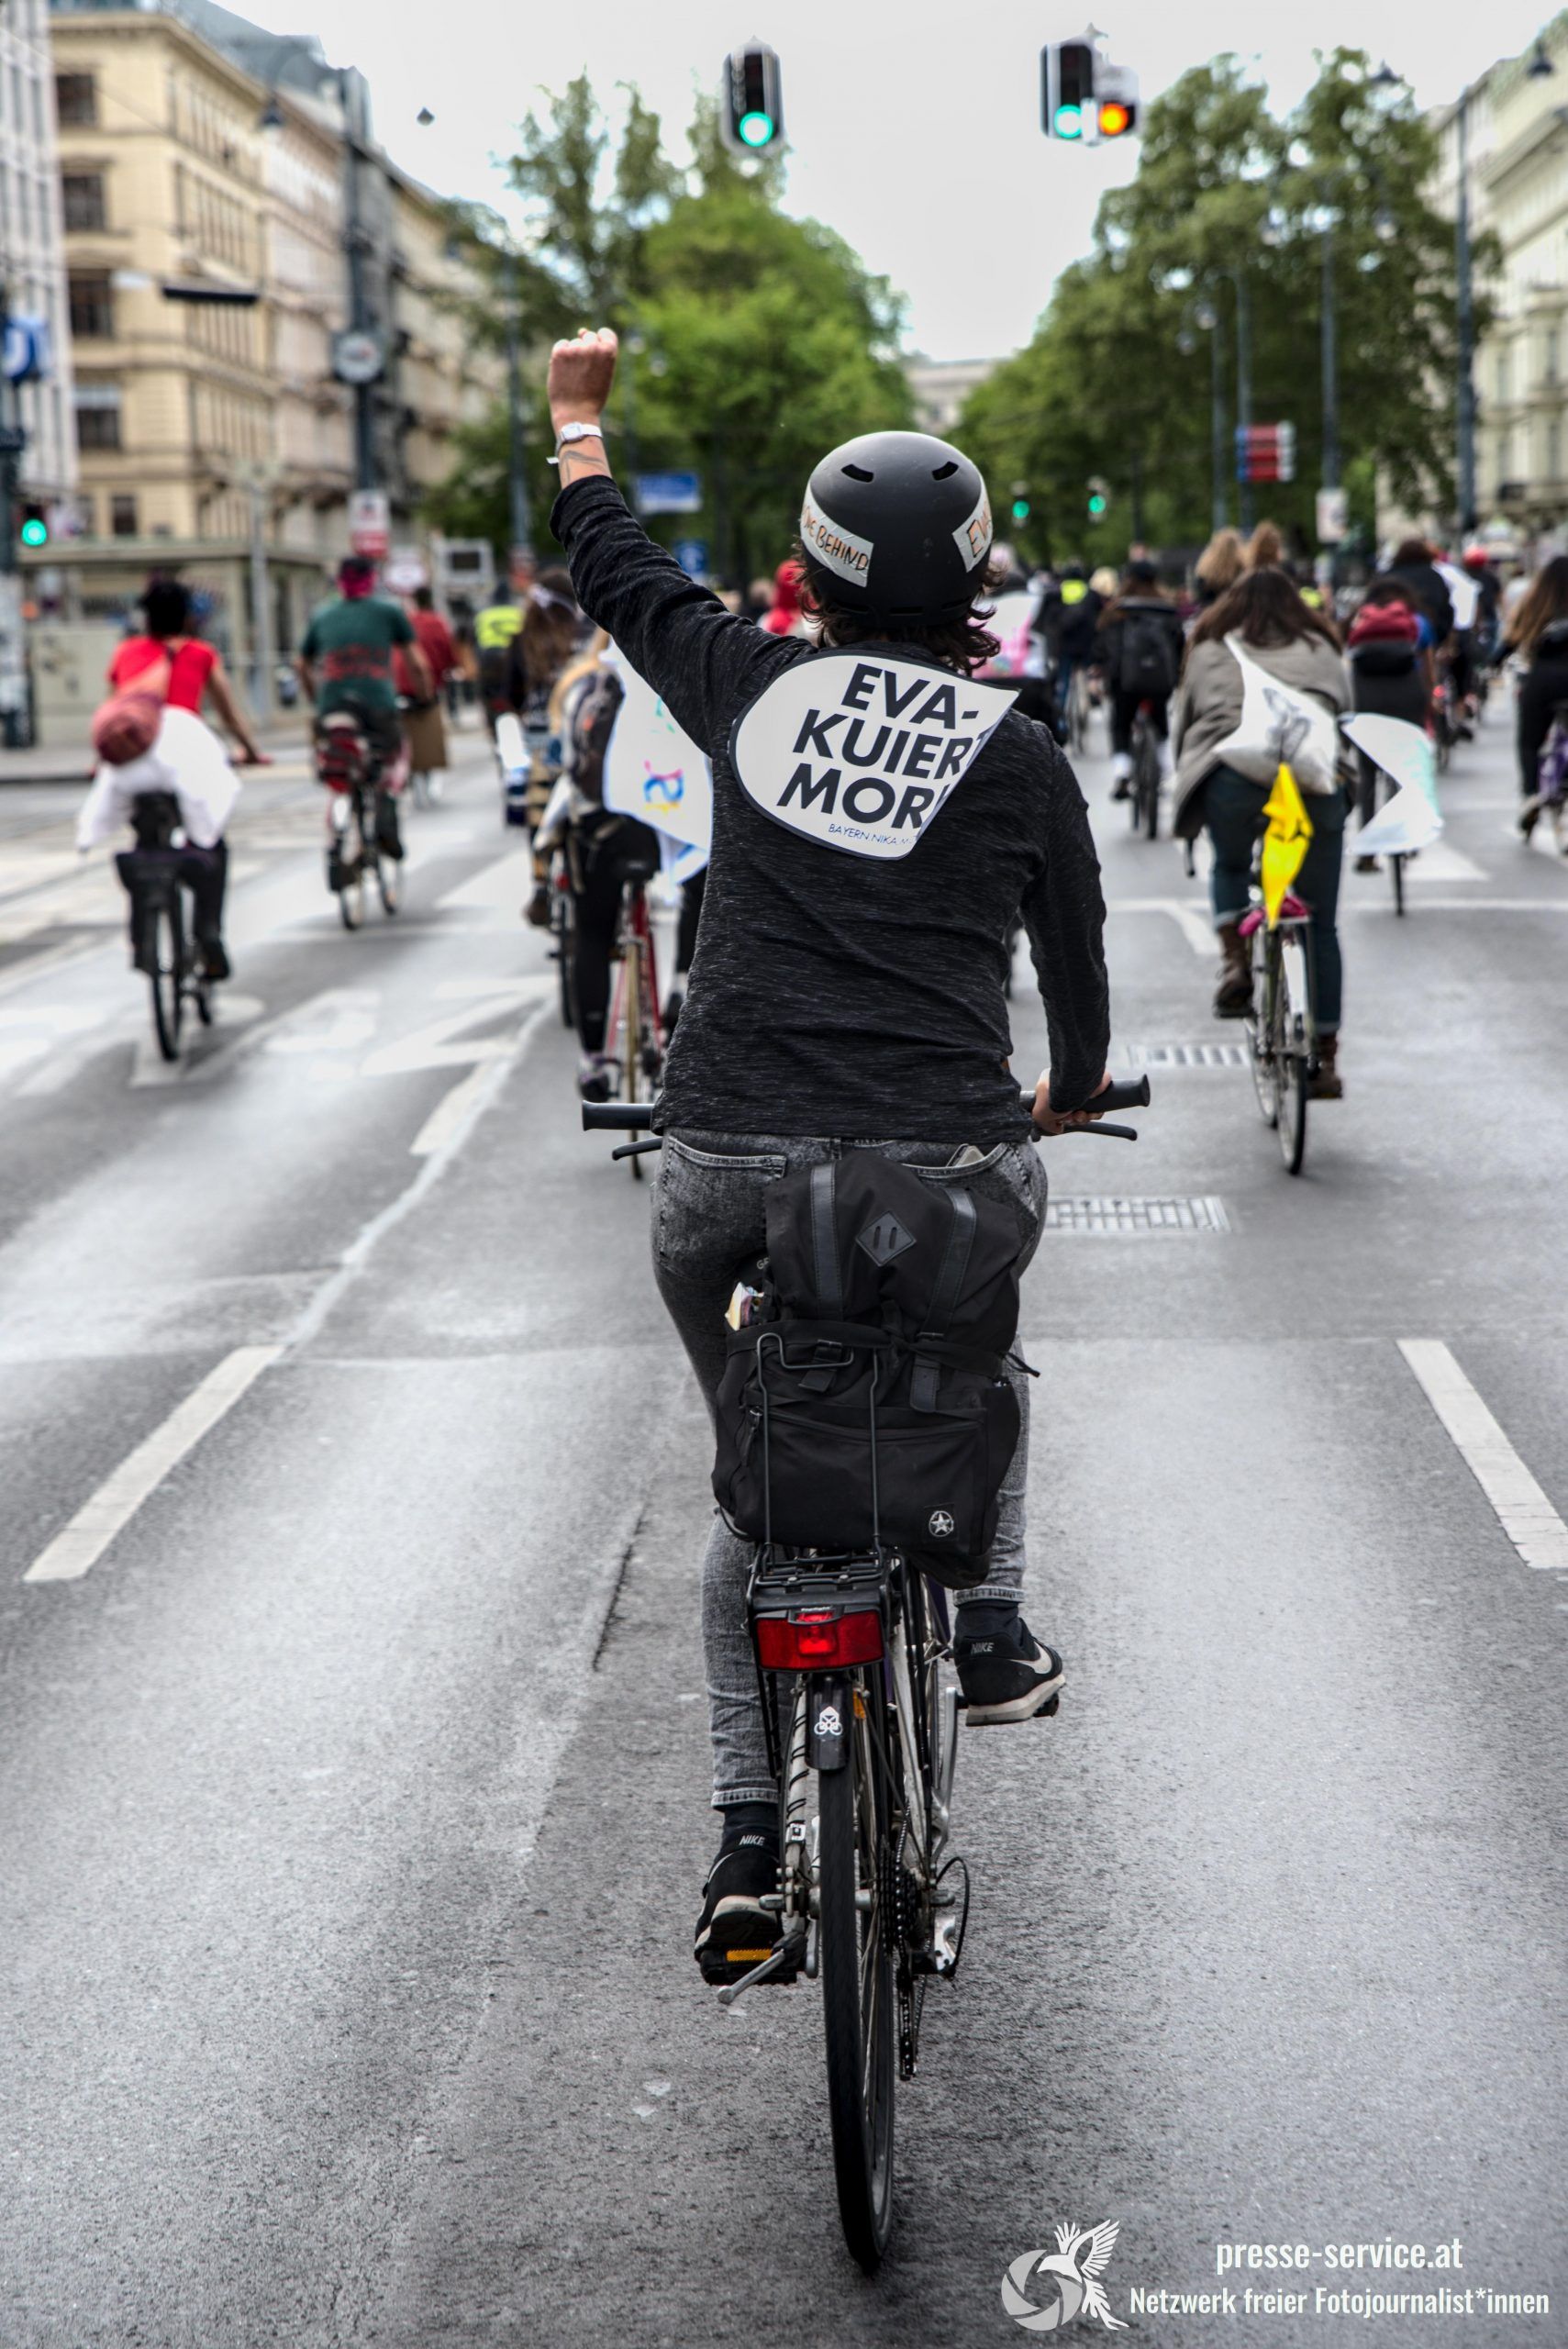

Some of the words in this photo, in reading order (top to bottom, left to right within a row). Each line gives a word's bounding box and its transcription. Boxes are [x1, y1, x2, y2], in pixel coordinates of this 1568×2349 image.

[816, 525, 870, 571] BEHIND
[841, 662, 979, 730] EVA-
[970, 1642, 995, 1655] NIKE
[739, 1834, 766, 1846] NIKE
